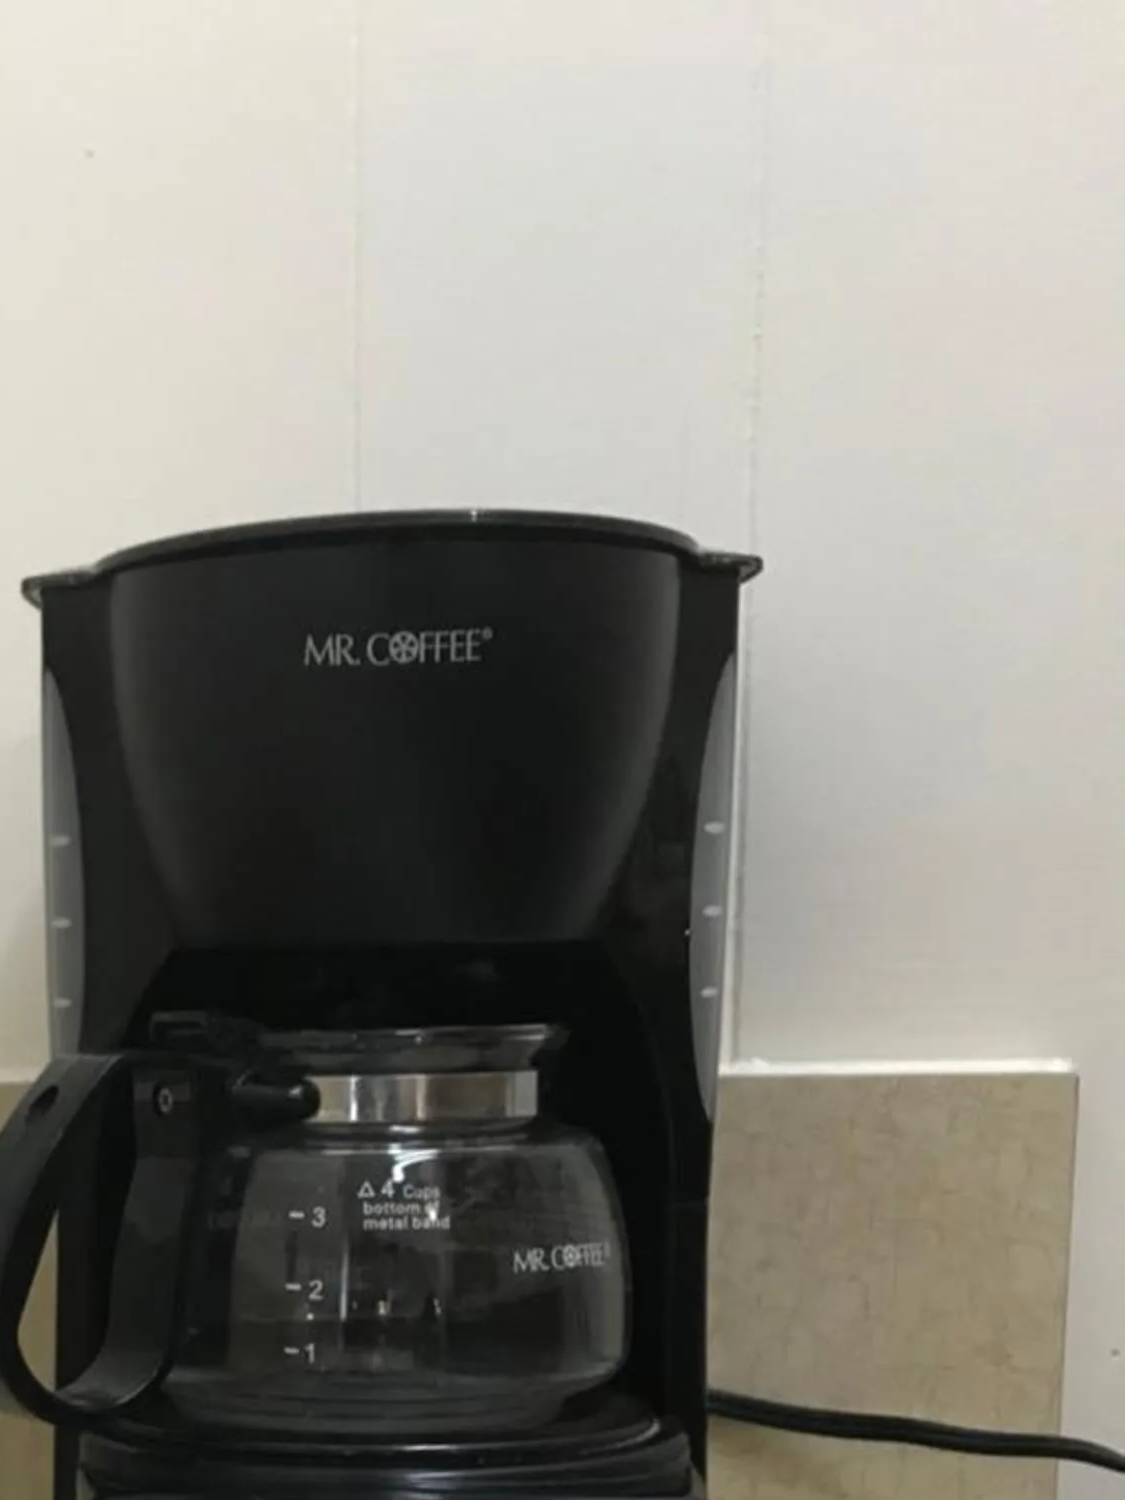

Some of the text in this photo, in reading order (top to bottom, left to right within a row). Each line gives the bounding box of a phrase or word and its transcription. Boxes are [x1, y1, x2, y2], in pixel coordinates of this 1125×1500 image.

[311, 1206, 327, 1228] 3
[363, 1201, 421, 1216] bottom
[363, 1215, 410, 1231] metal
[308, 1280, 324, 1301] 2
[304, 1343, 316, 1365] 1
